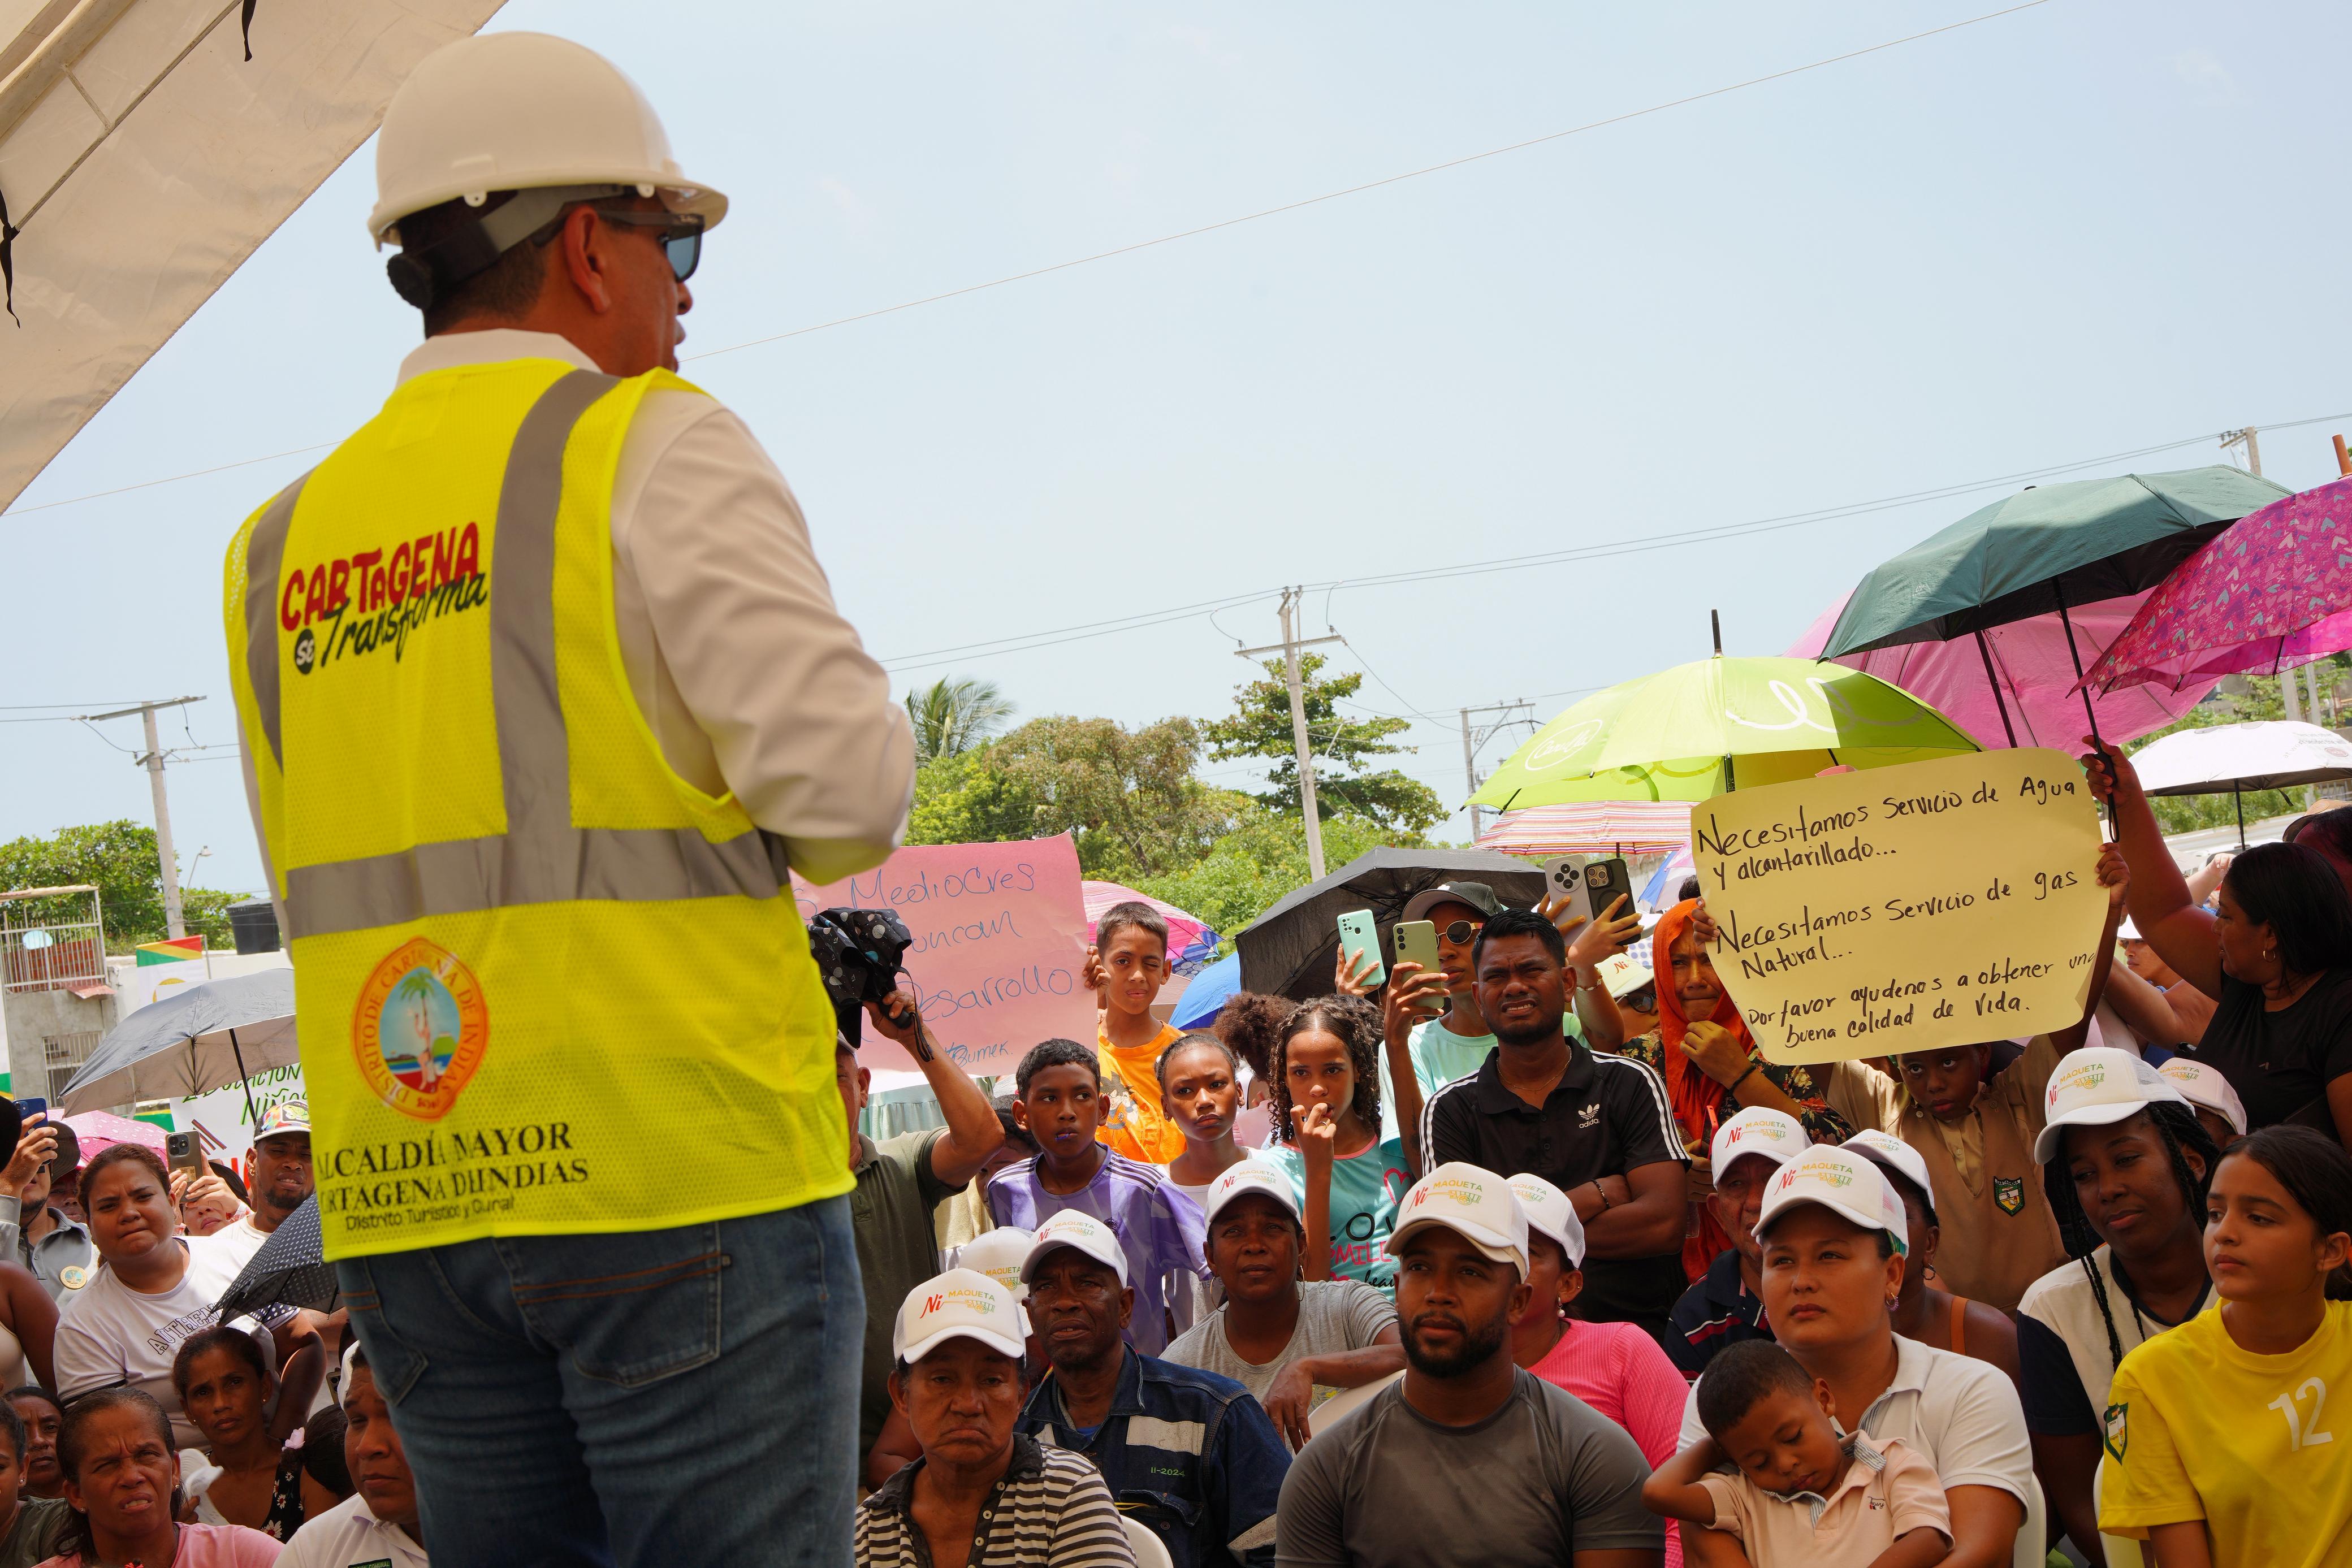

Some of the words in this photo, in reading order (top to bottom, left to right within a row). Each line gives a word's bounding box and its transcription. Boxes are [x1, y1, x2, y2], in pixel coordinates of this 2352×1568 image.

[281, 521, 479, 631] CARTAGENA
[296, 640, 315, 665] SE
[322, 572, 488, 668] Transforma
[1697, 805, 1869, 856] Necesitamos
[1971, 781, 1999, 804] de
[2019, 776, 2075, 805] Agua
[1717, 905, 1872, 955] Necesitamos
[1986, 877, 2012, 900] de
[2034, 871, 2078, 900] gas
[1780, 997, 1837, 1028] favor
[1957, 974, 1969, 987] a
[1978, 956, 2054, 985] obtener
[364, 993, 384, 1021] DE
[1784, 1023, 1837, 1049] buena
[1932, 998, 1954, 1019] de
[361, 1024, 411, 1104] DISTRITO
[2060, 1063, 2104, 1084] MAQUETA
[2049, 1084, 2057, 1115] Ni
[1579, 1118, 1600, 1129] adidas
[1745, 1121, 1787, 1129] MAQUETA
[1725, 1126, 1743, 1149] Ni
[1859, 1137, 1900, 1146] AQUETA
[1801, 1162, 1853, 1175] MAQUETA
[1219, 1175, 1236, 1194] Ni
[1433, 1180, 1482, 1192] MAQUETA
[1774, 1169, 1797, 1196] Ni
[1407, 1186, 1429, 1214] Ni
[1036, 1228, 1050, 1245] Ni
[1054, 1220, 1095, 1229] MAQUETA
[985, 1266, 1021, 1276] MAQUETA
[919, 1293, 944, 1319] Ni
[948, 1289, 995, 1302] MAQUETA
[2267, 1376, 2334, 1452] 12
